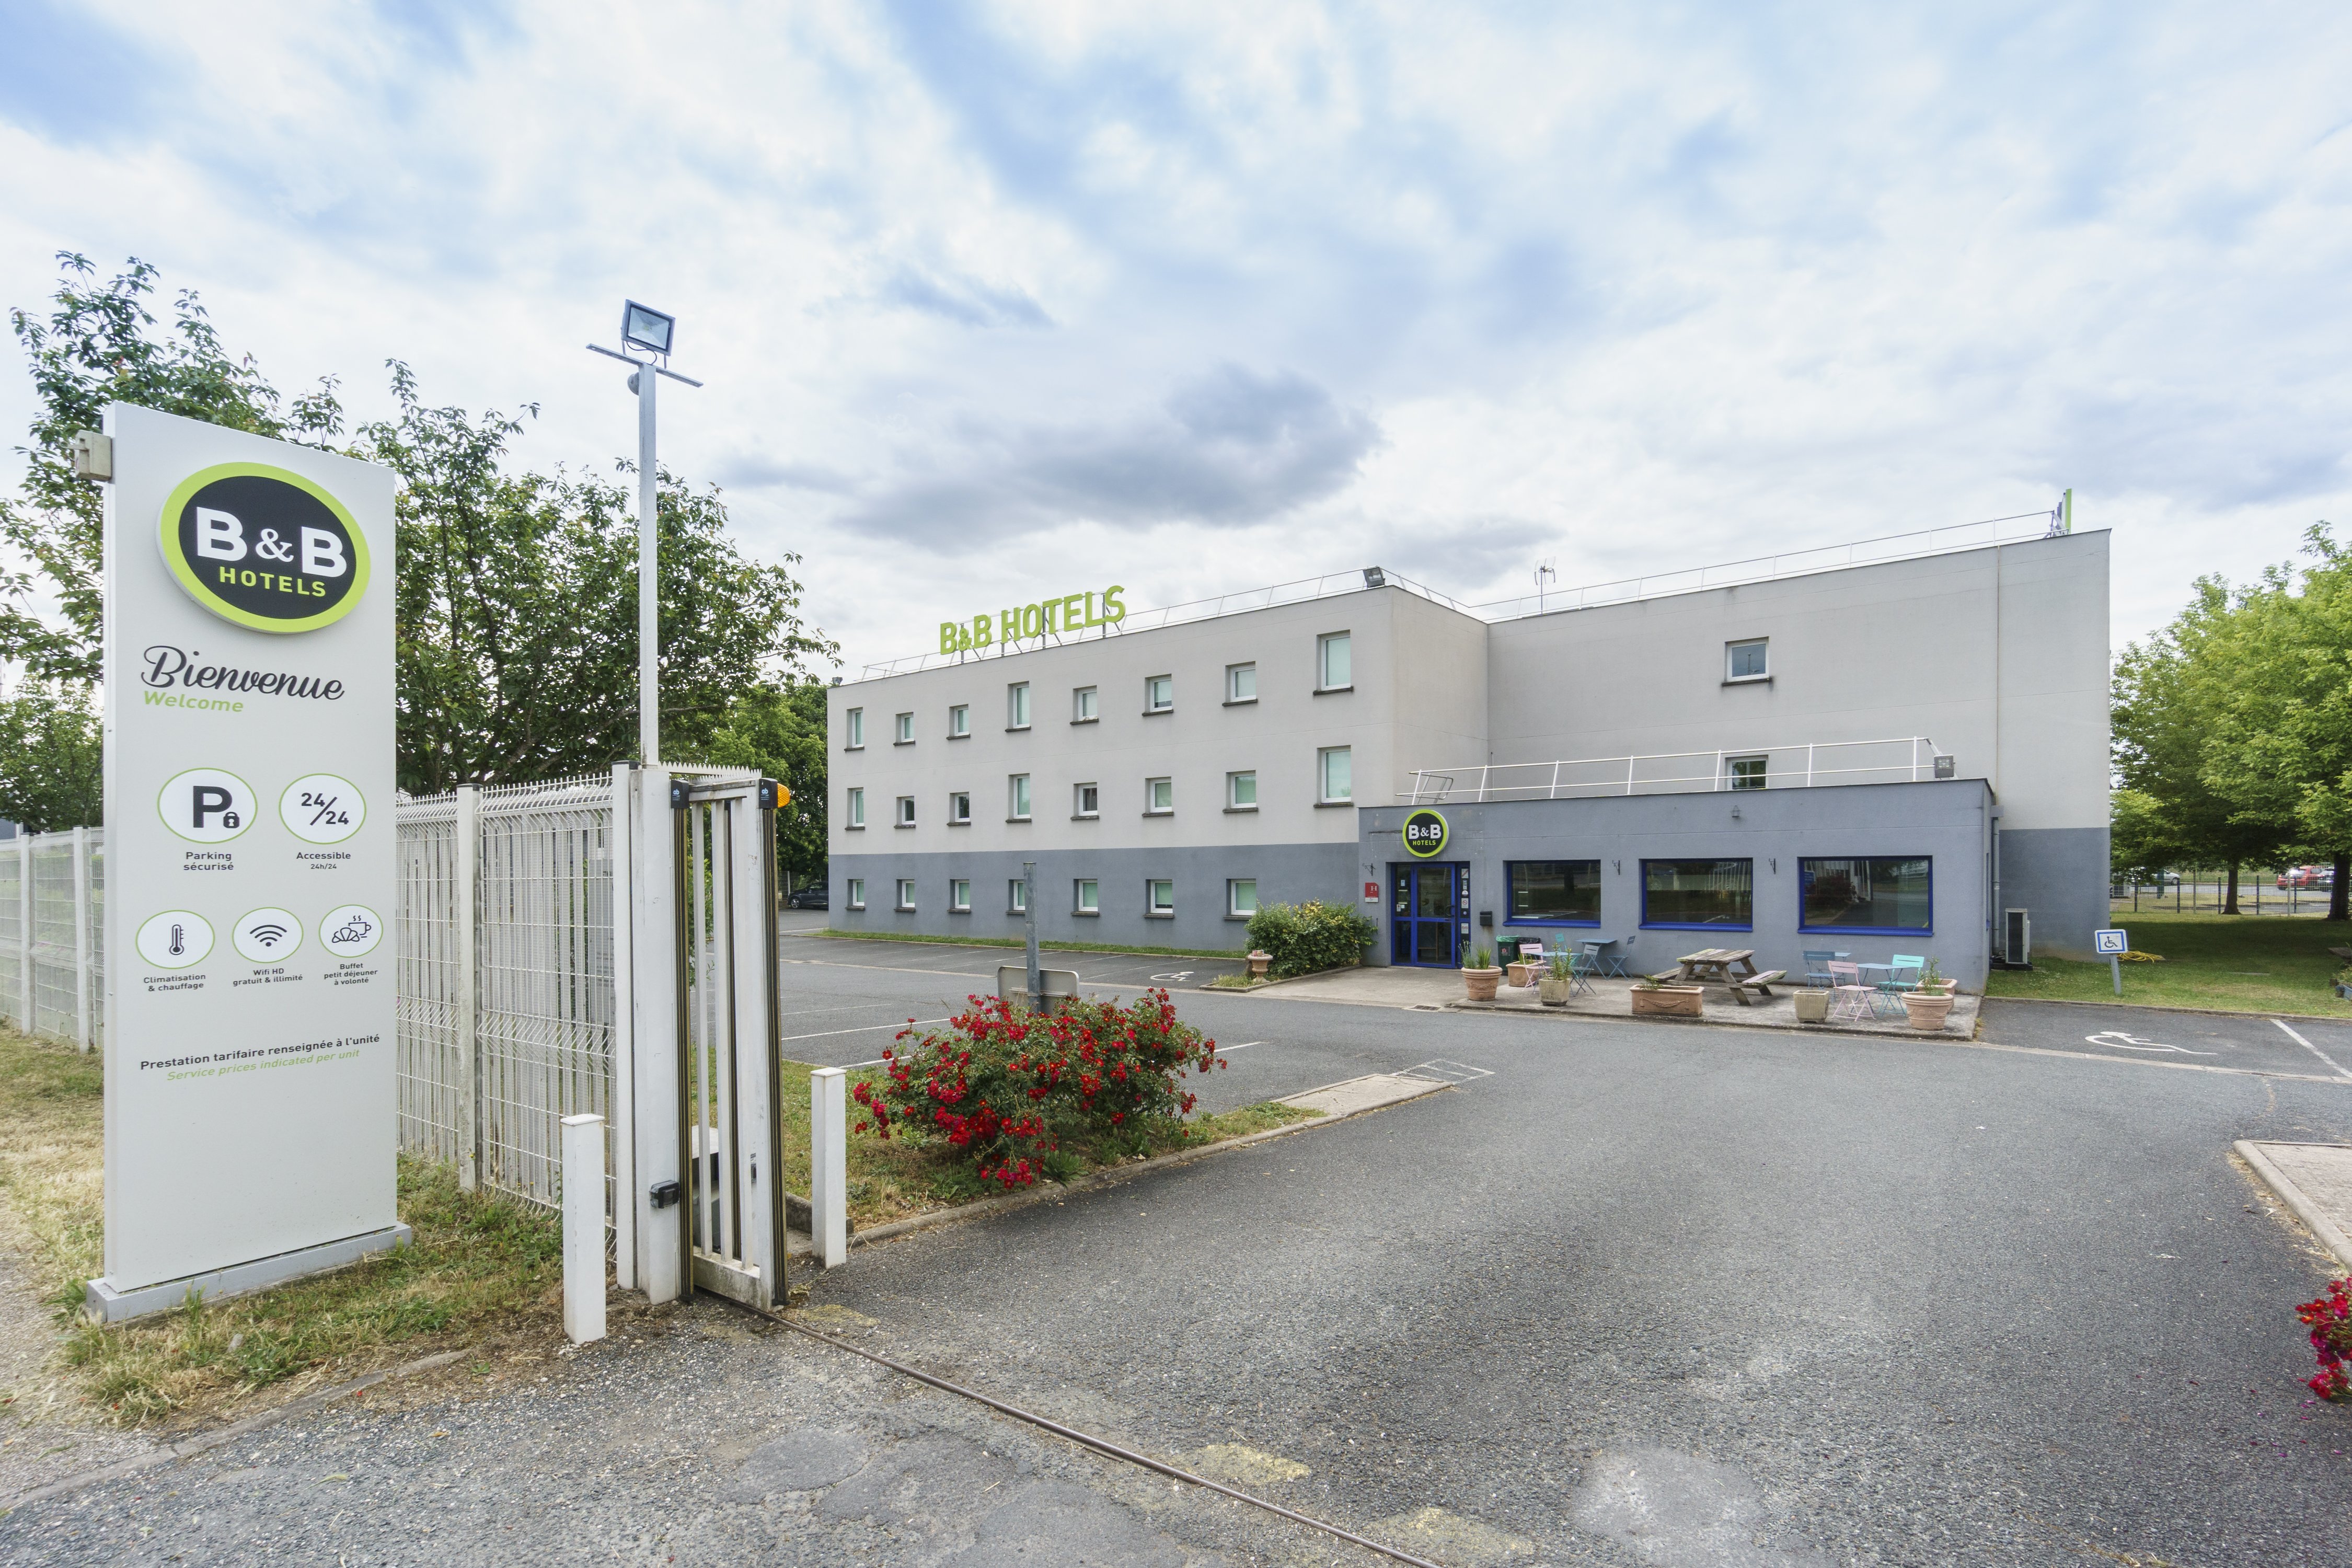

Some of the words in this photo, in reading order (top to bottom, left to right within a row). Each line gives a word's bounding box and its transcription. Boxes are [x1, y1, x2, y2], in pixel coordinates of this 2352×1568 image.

[220, 566, 326, 597] HOTELS
[940, 614, 992, 655] B&B
[1001, 585, 1126, 644] HOTELS
[141, 645, 345, 700] Bienvenue
[144, 691, 244, 713] Welcome
[1409, 824, 1442, 839] B&B
[186, 851, 232, 861] Parking
[296, 851, 351, 860] Accessible
[183, 862, 234, 871] sécurisé
[143, 974, 206, 984] Climatisation
[233, 977, 262, 987] gratuit
[273, 974, 303, 983] illimité
[158, 983, 204, 991] chauffage
[140, 1055, 210, 1070] Prestation
[214, 1049, 264, 1062] tarifaire
[268, 1040, 333, 1055] renseignée
[336, 1038, 342, 1047] à
[345, 1034, 380, 1046] l'unité
[167, 1067, 215, 1081] Service
[218, 1063, 257, 1077] prices
[260, 1055, 314, 1069] indicated
[316, 1053, 336, 1064] per
[339, 1049, 360, 1059] unit
